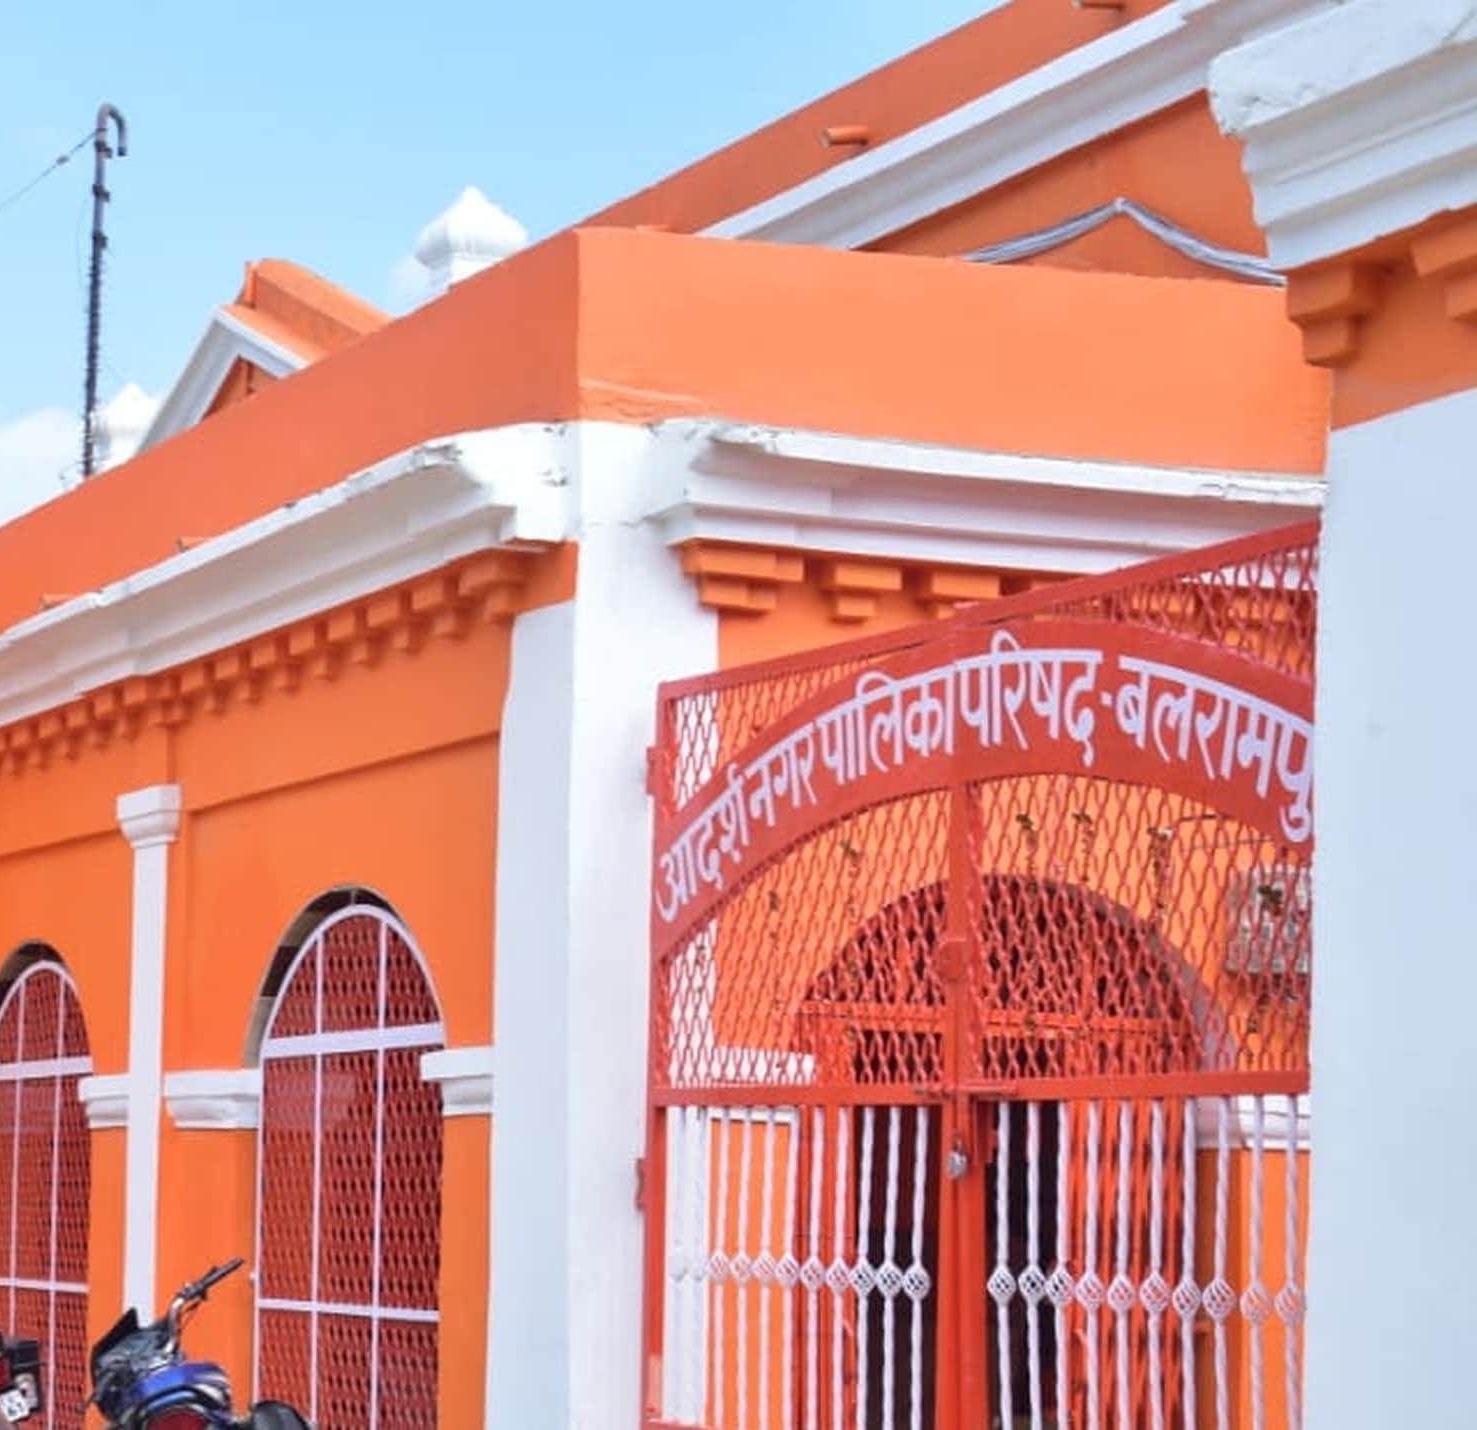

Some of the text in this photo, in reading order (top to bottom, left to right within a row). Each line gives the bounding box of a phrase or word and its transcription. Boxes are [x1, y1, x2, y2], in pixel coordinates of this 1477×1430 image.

[655, 762, 750, 922] आदर्श
[744, 721, 817, 827] नगर
[814, 671, 957, 785] पालिका
[955, 629, 1103, 767] परिषद
[1119, 655, 1314, 842] बलरामपु
